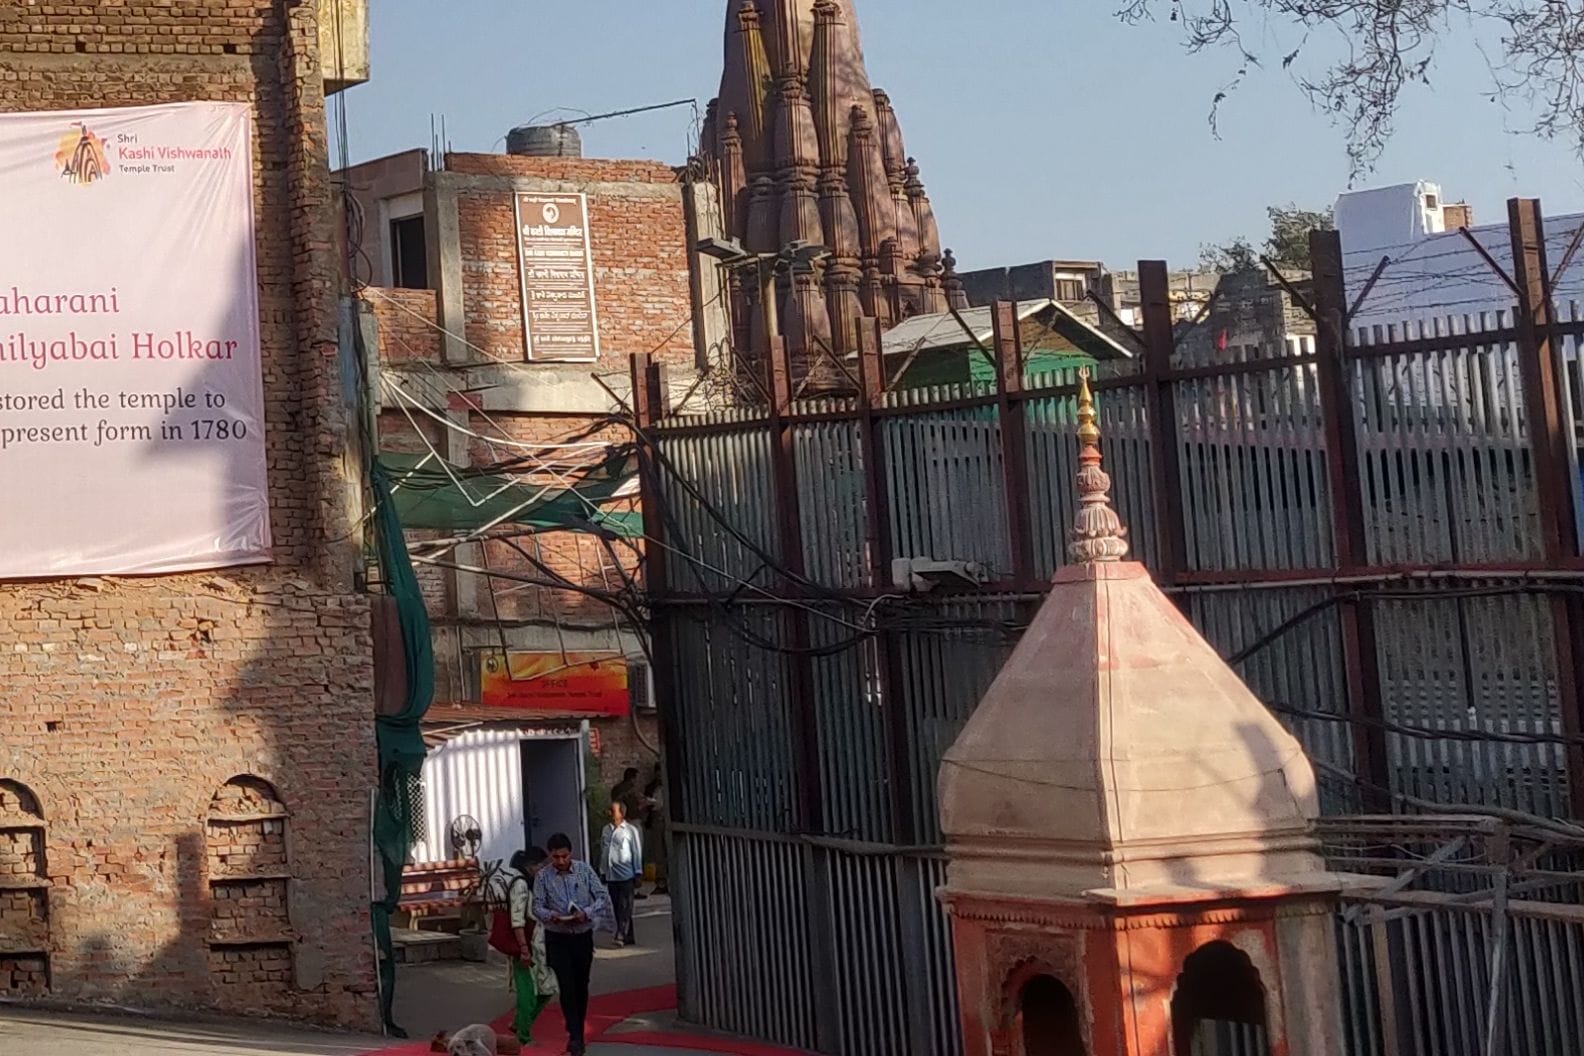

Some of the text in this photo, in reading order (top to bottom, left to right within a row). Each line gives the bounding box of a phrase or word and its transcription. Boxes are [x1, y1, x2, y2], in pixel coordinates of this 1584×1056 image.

[117, 134, 138, 144] Shri
[118, 146, 232, 160] Kashi Vishwanath
[119, 165, 175, 174] Temple Trust
[131, 331, 238, 360] Holkar
[74, 389, 110, 409] the
[119, 387, 196, 414] temple
[205, 390, 226, 408] to
[1, 424, 88, 448] present
[94, 419, 152, 446] form
[161, 420, 182, 440] in
[191, 419, 247, 440] 1780
